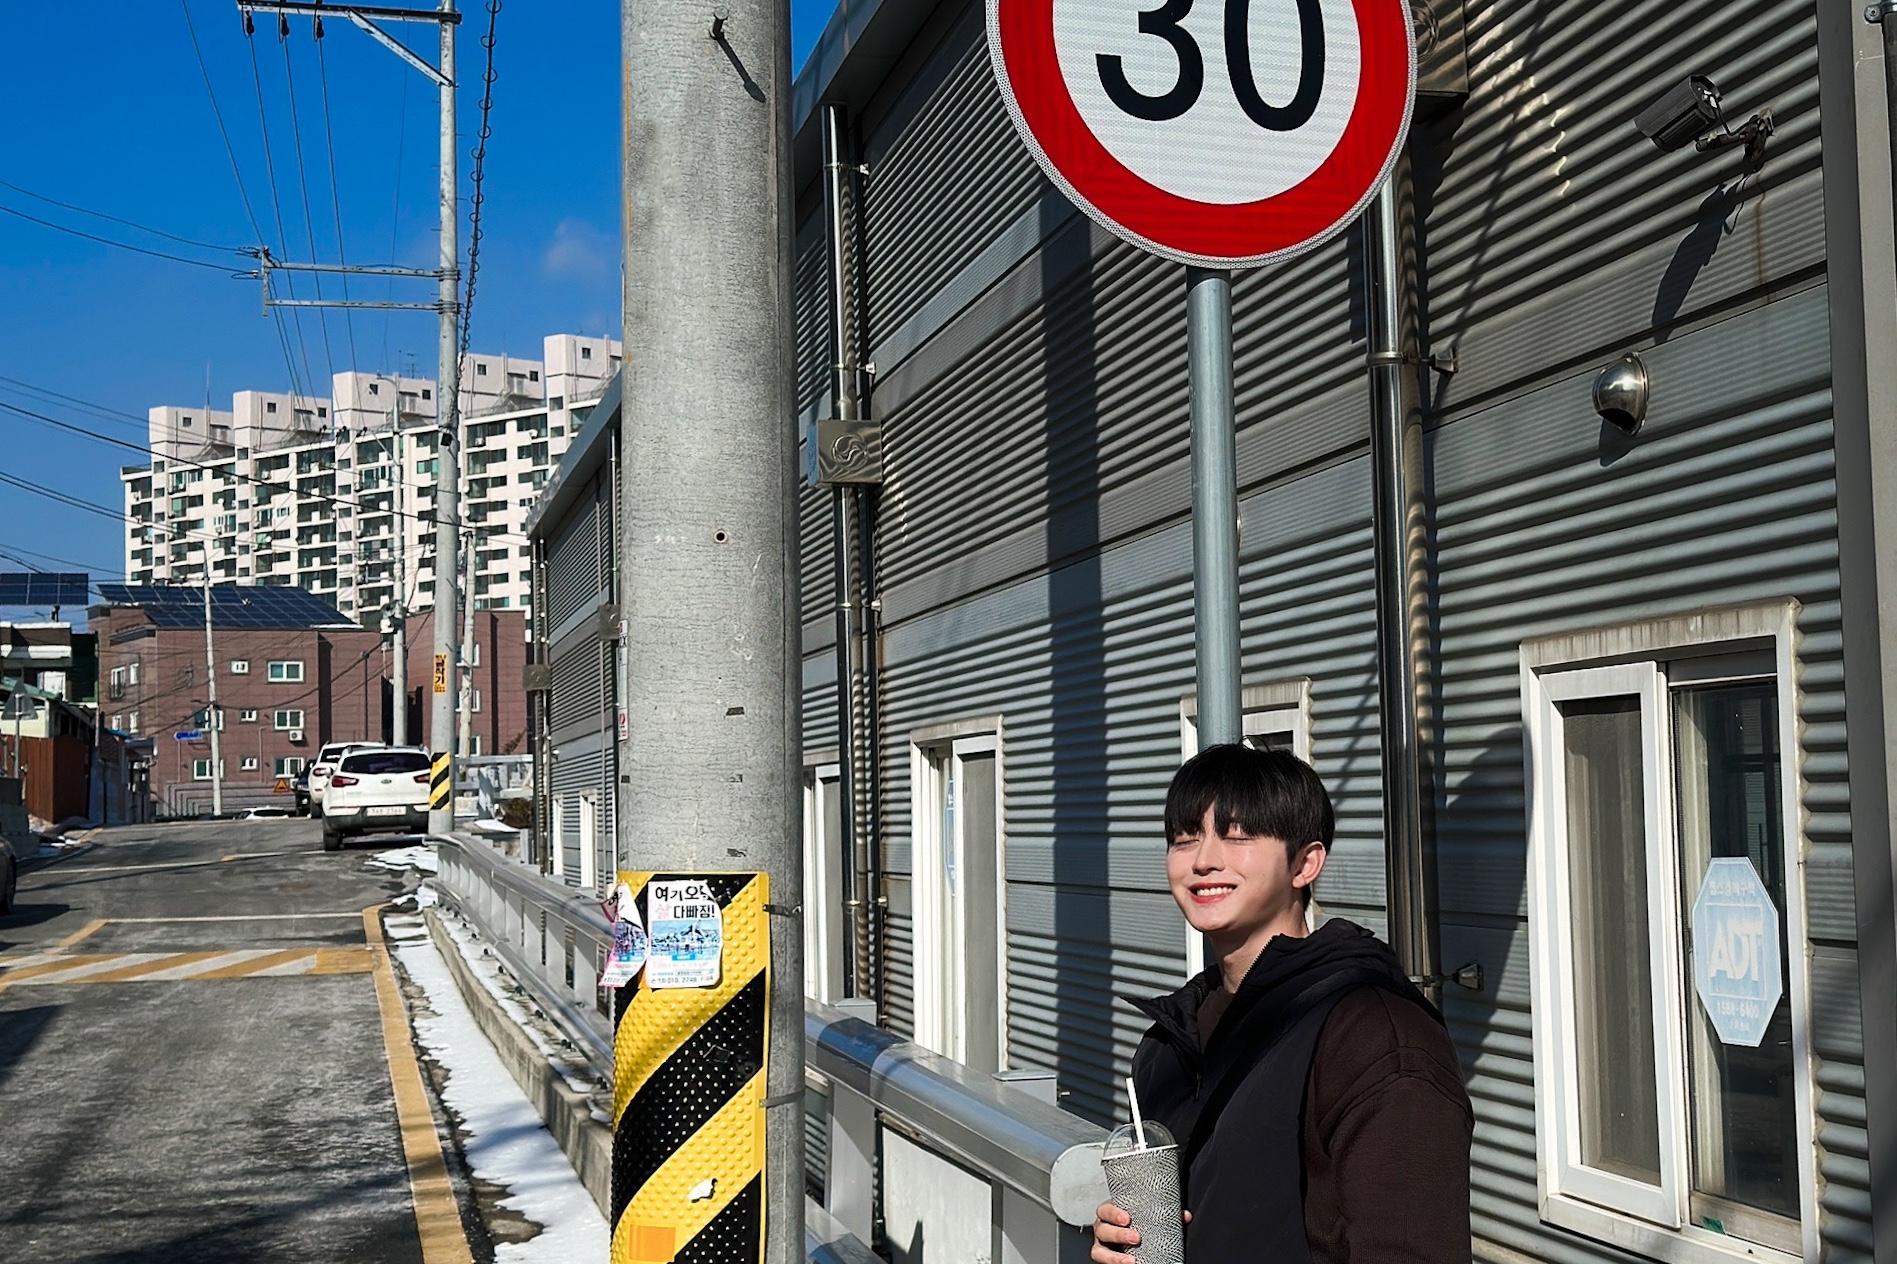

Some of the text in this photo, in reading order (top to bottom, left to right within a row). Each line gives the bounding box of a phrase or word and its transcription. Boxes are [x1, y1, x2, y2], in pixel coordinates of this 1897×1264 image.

[1095, 0, 1326, 132] 30
[673, 904, 715, 919] 다빠짐!
[1710, 918, 1764, 982] ADT
